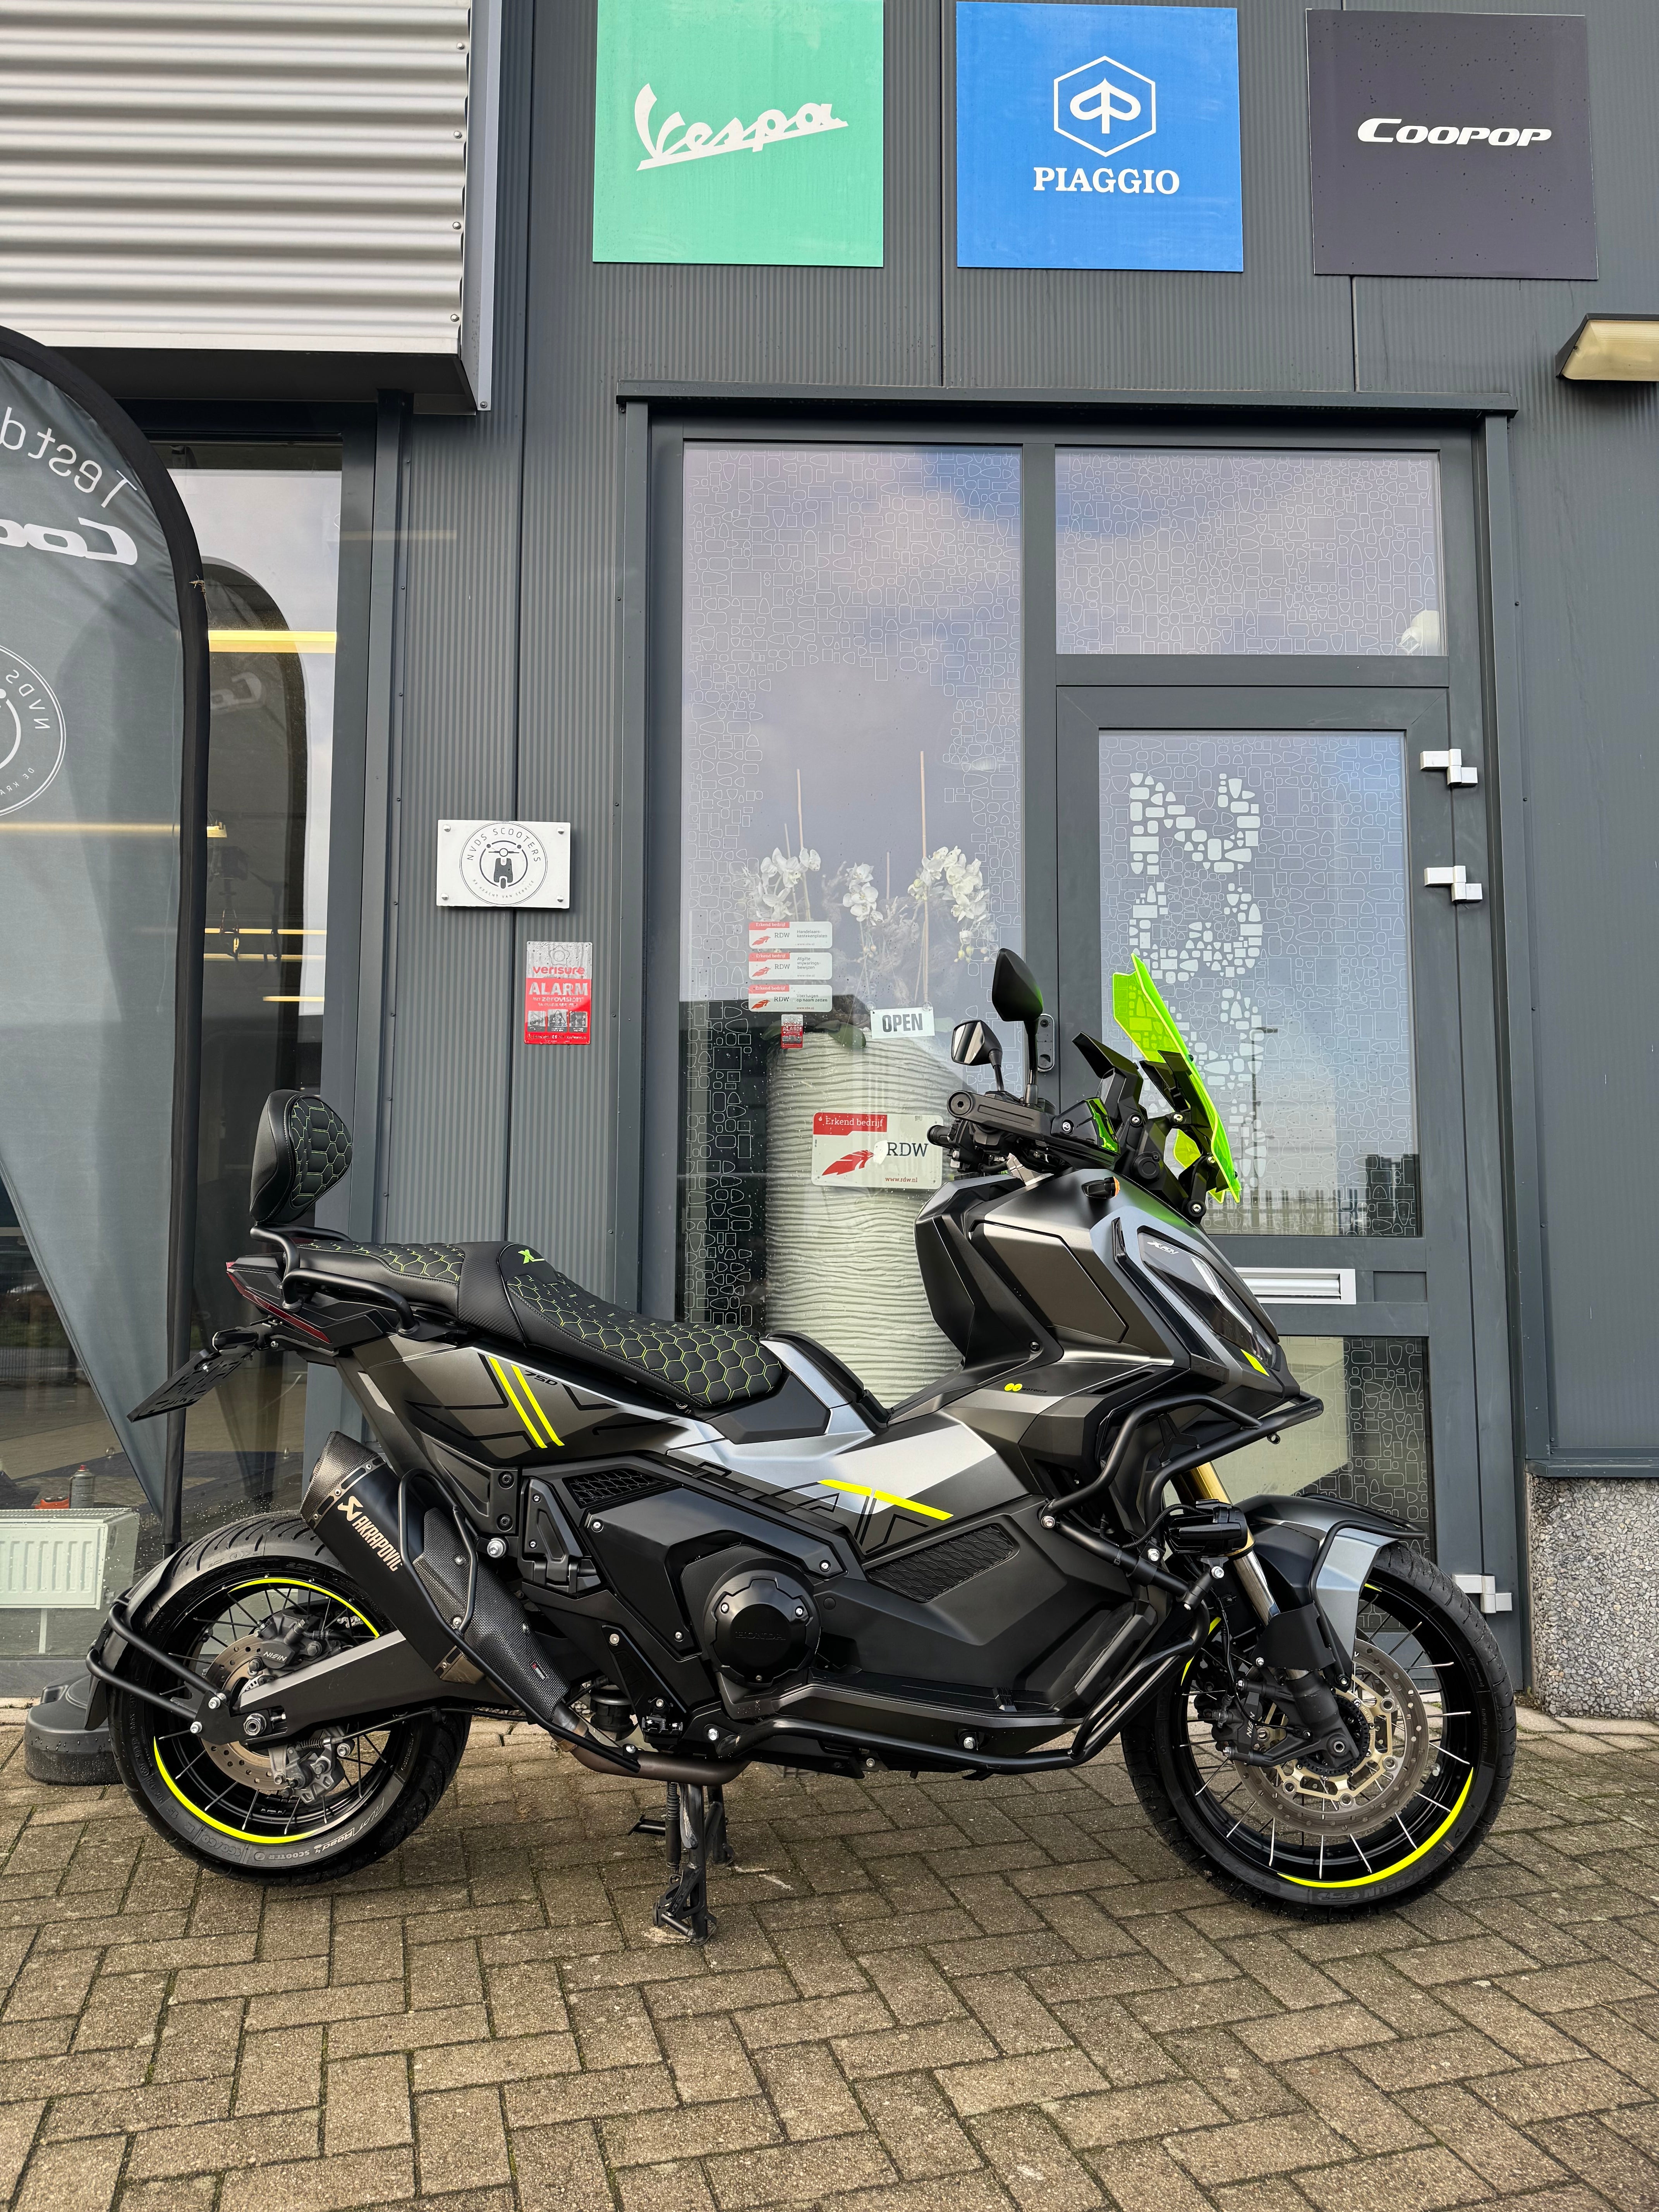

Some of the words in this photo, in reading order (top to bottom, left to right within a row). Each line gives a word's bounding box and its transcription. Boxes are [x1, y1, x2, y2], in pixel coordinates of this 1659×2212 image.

[634, 83, 848, 171] Vespa
[1033, 167, 1180, 194] PIAGGIO
[467, 833, 487, 860] NVDS
[493, 828, 541, 862] SCOOTERS
[532, 966, 585, 975] verisure
[529, 982, 588, 996] ALARM
[882, 1013, 923, 1032] OPEN
[825, 1117, 854, 1126] Erkend
[857, 1118, 883, 1128] bedrijf
[887, 1142, 929, 1157] RDW
[268, 1850, 310, 1860] SCOOTER
